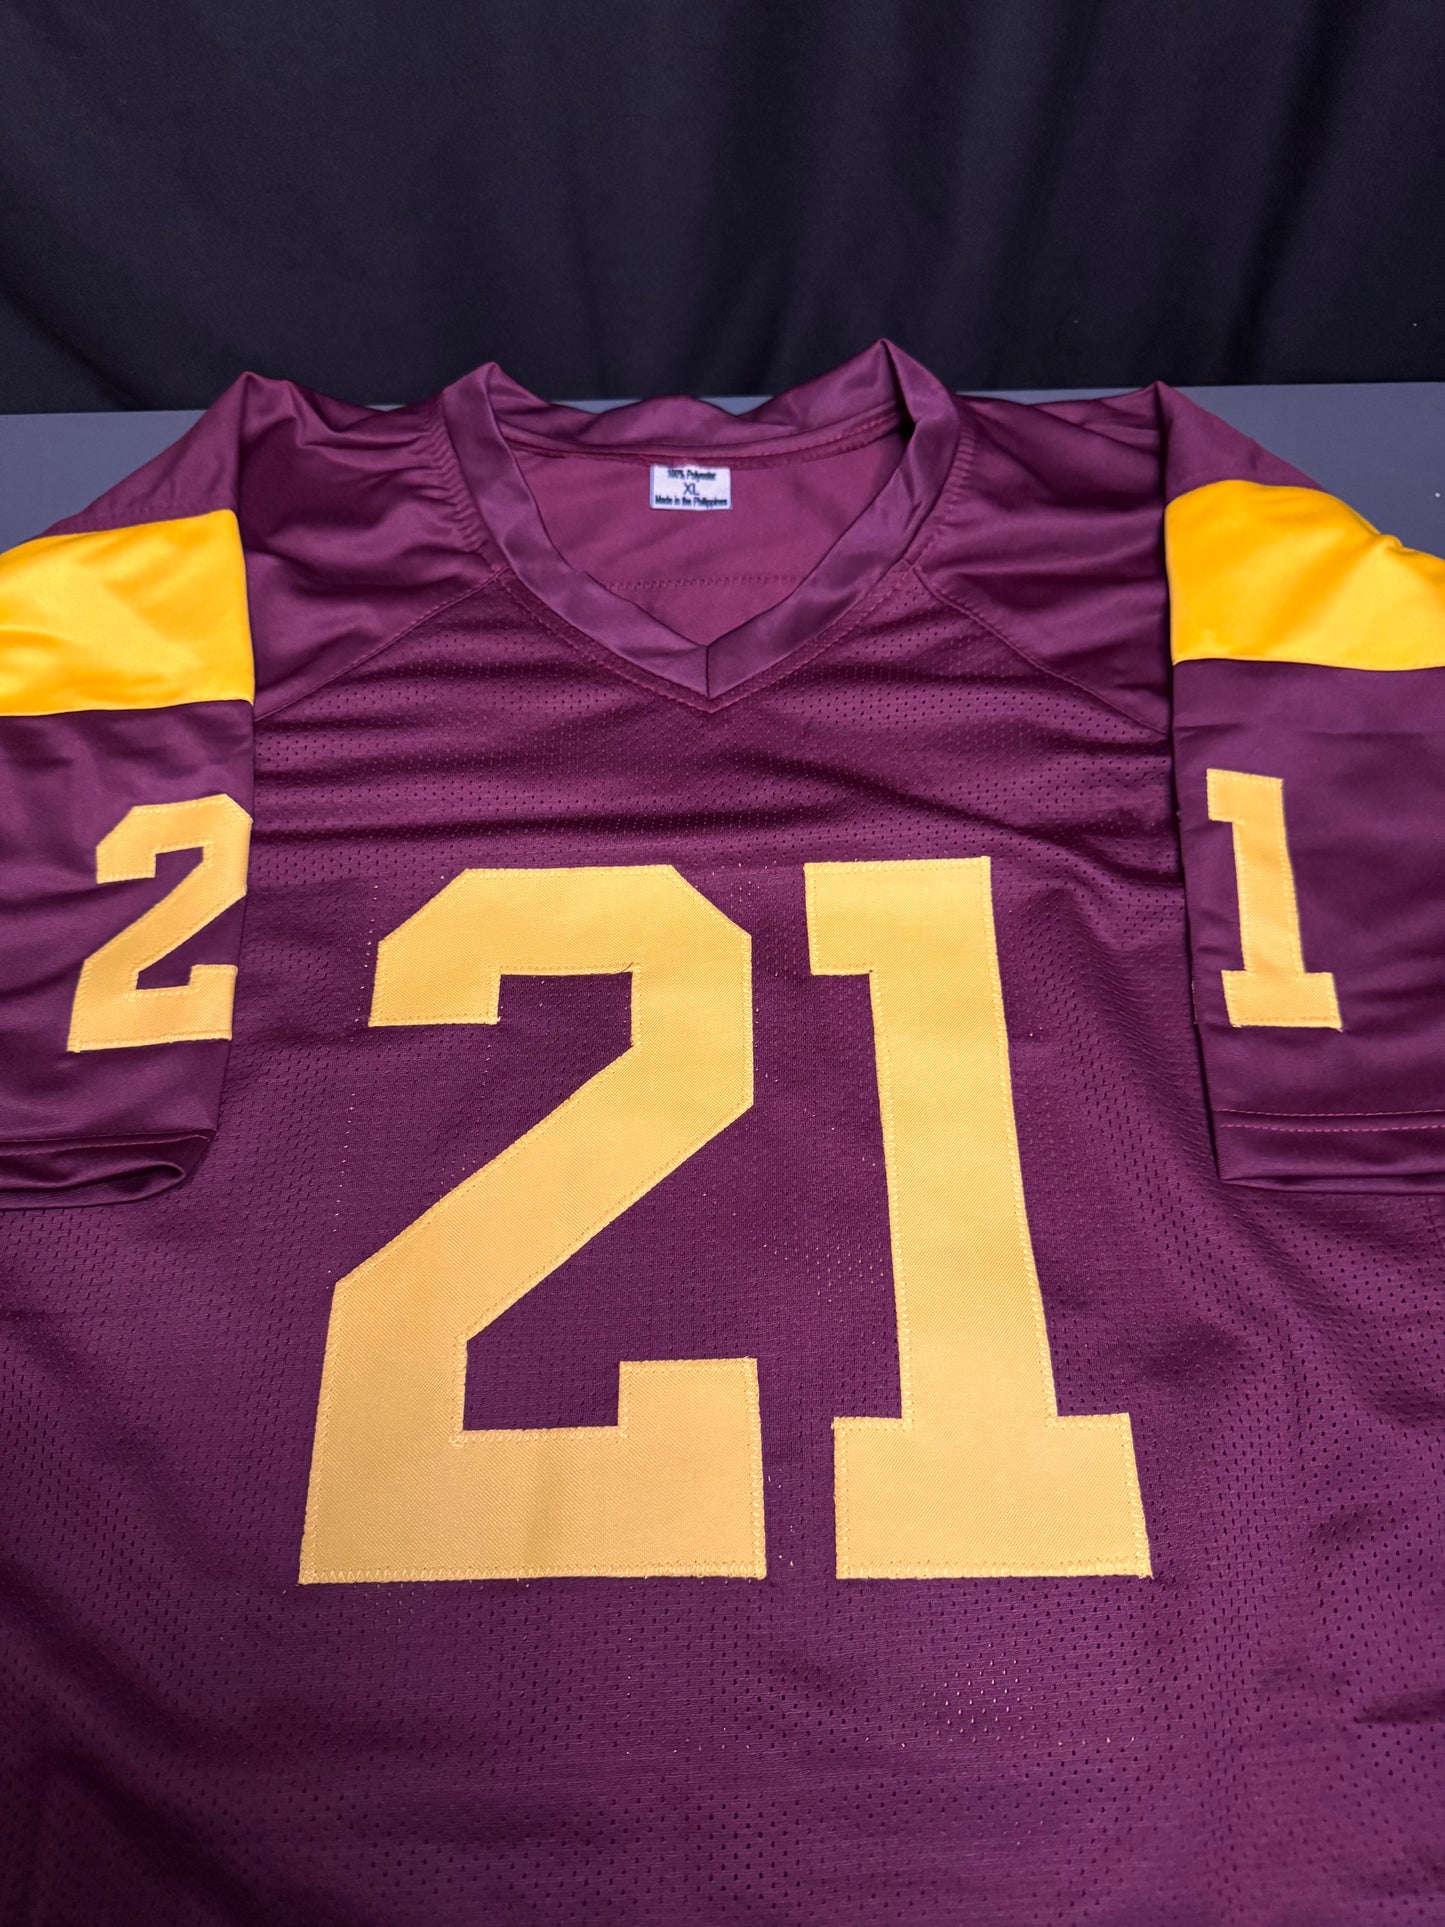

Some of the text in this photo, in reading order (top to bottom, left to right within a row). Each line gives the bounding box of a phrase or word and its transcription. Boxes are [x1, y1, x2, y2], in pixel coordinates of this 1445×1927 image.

[655, 495, 673, 505] Made
[674, 496, 680, 505] in
[682, 496, 692, 506] the
[683, 482, 700, 496] XL
[687, 469, 717, 482] Polyester
[67, 794, 253, 1052] 2
[1206, 768, 1342, 1030] 1
[299, 856, 1152, 1584] 21
